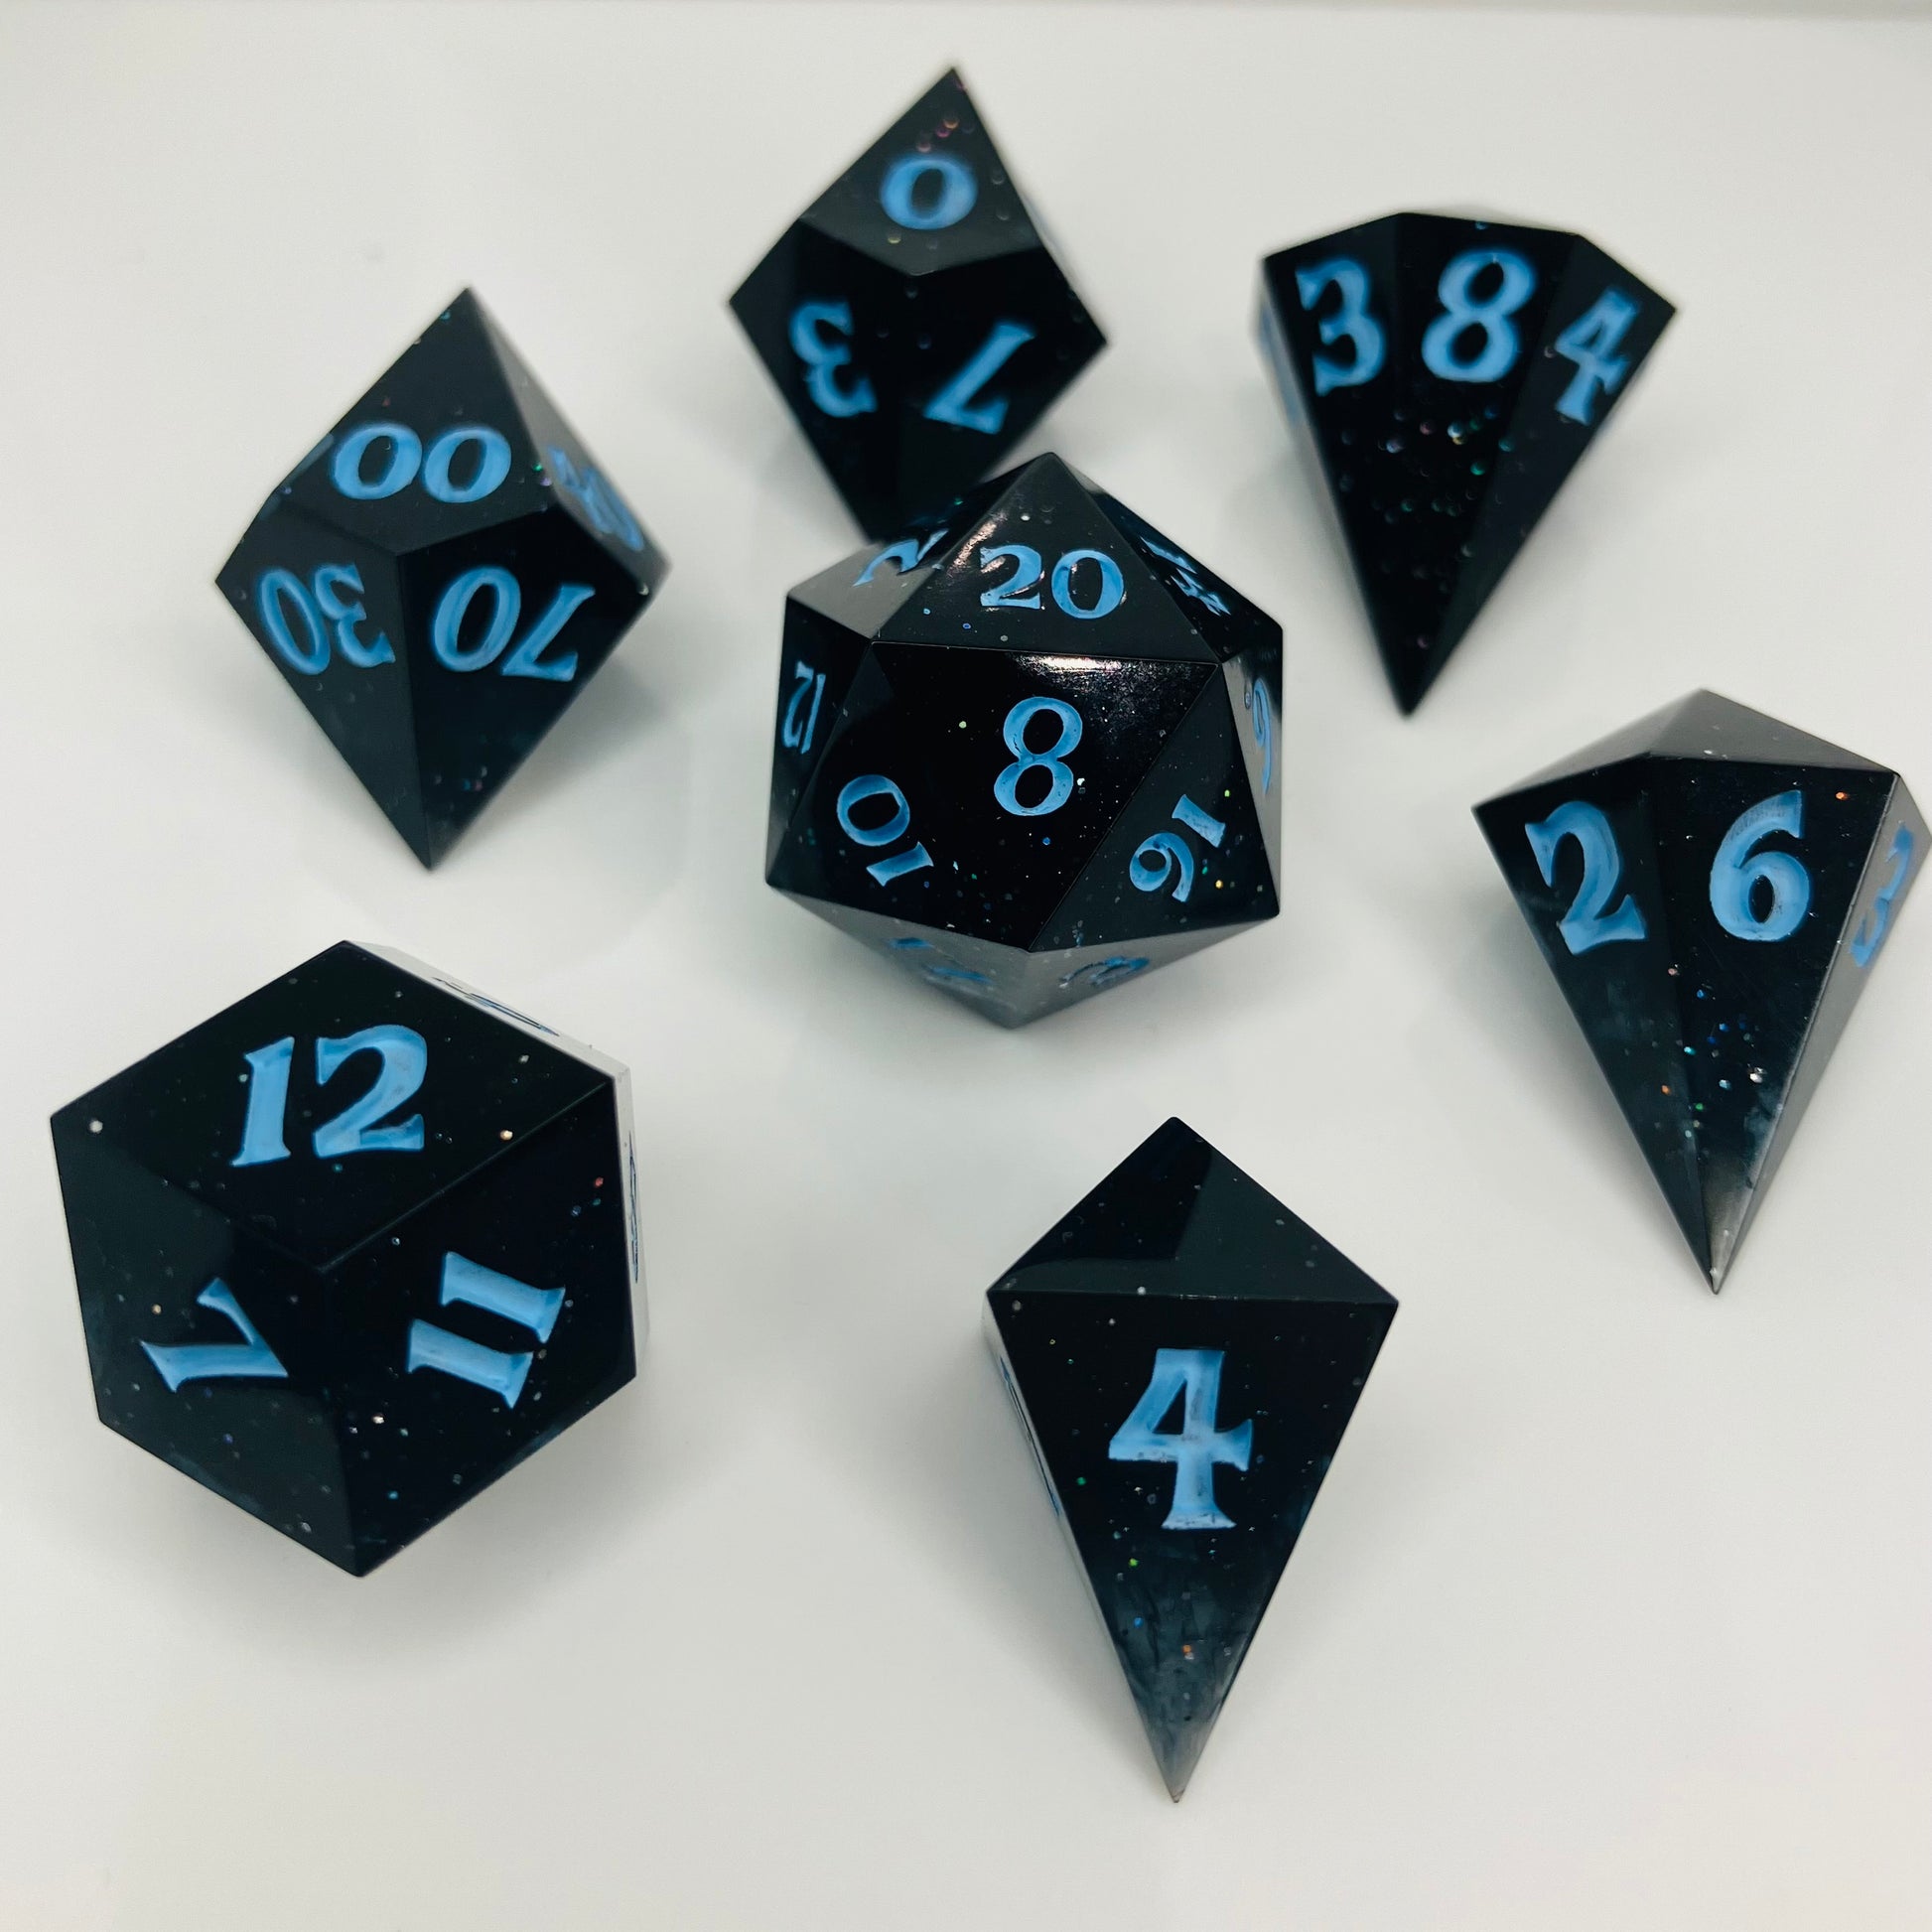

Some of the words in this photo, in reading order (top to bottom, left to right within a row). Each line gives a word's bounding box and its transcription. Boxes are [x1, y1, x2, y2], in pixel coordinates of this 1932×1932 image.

[879, 152, 978, 230] 0
[789, 301, 877, 417] 3
[1295, 257, 1386, 395] 3
[1421, 248, 1537, 383] 8
[1555, 289, 1639, 426] 4
[923, 321, 1035, 435] 7
[330, 421, 511, 504] 00
[255, 563, 396, 676] 30
[431, 567, 596, 682] 70
[979, 543, 1125, 620] 20
[993, 696, 1083, 817] 8
[836, 774, 934, 888] 10
[1129, 793, 1227, 903] 16
[1524, 800, 1648, 956] 2
[1709, 789, 1812, 942] 6
[229, 1024, 429, 1168] 12
[140, 1277, 289, 1394] 7
[406, 1250, 571, 1410] 11
[1107, 1348, 1254, 1531] 4
